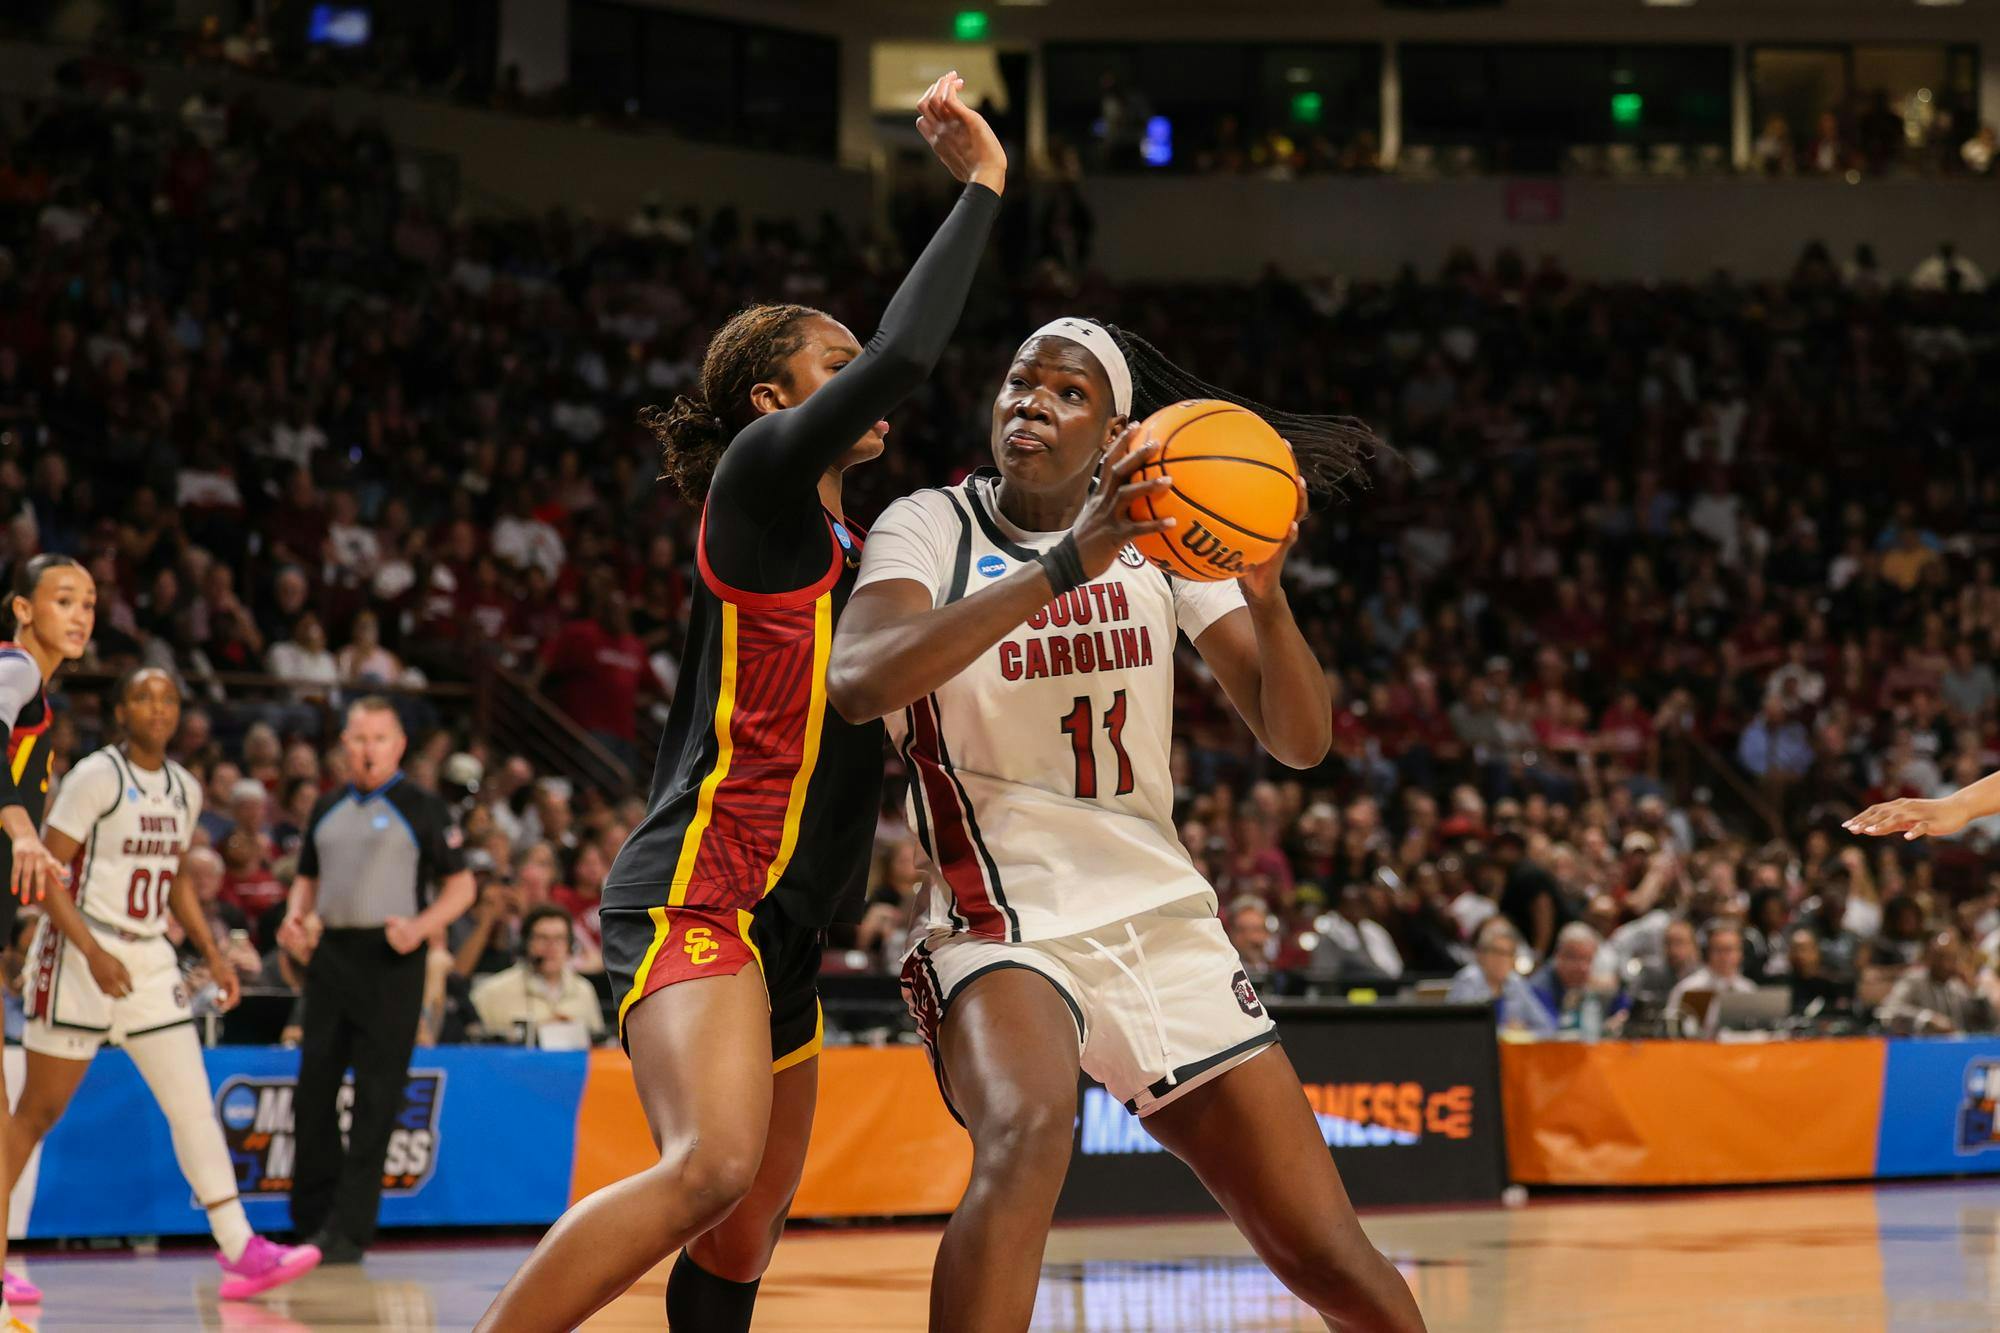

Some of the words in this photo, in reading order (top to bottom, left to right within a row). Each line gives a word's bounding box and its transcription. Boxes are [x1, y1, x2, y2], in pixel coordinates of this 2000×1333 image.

[981, 562, 1007, 573] NCAA
[998, 626, 1153, 681] CAROLINA
[1060, 688, 1135, 799] 11
[683, 927, 720, 965] SC
